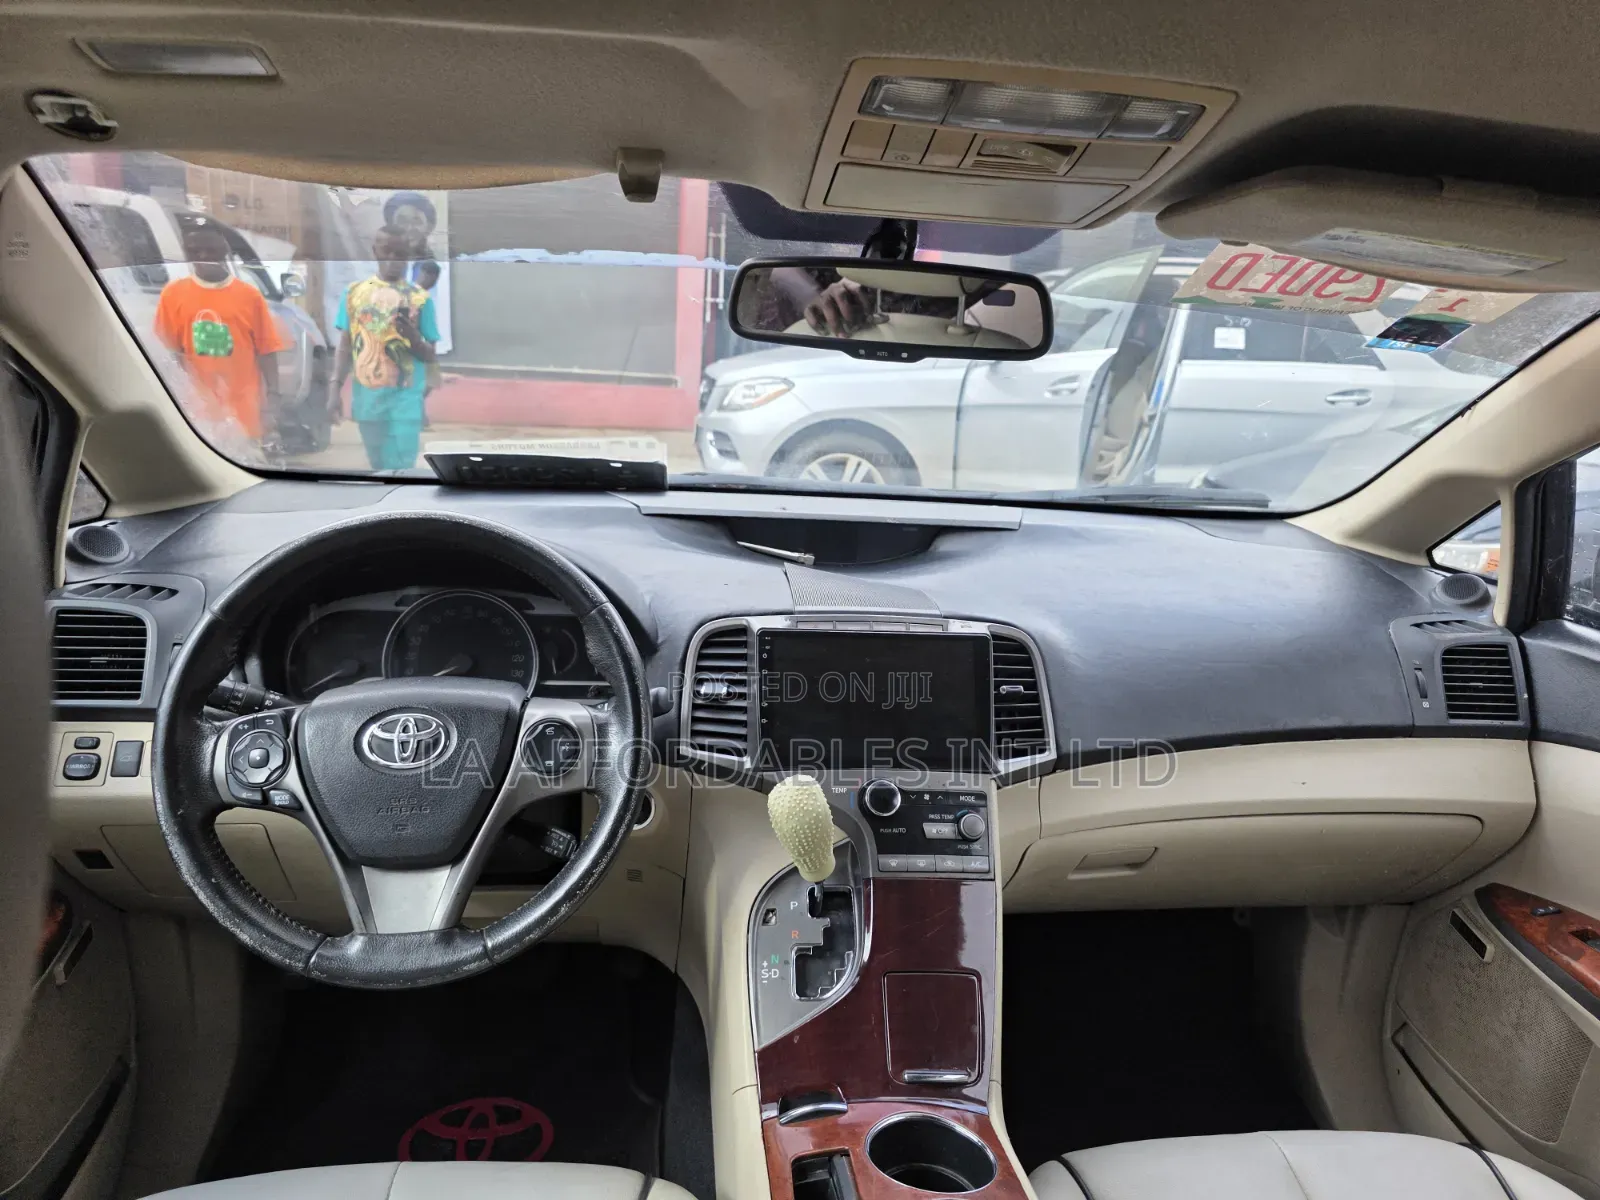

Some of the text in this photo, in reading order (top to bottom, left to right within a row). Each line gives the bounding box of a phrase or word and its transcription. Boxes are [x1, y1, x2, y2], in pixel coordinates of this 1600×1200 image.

[790, 901, 798, 910] P
[791, 930, 799, 939] R
[771, 954, 780, 964] N
